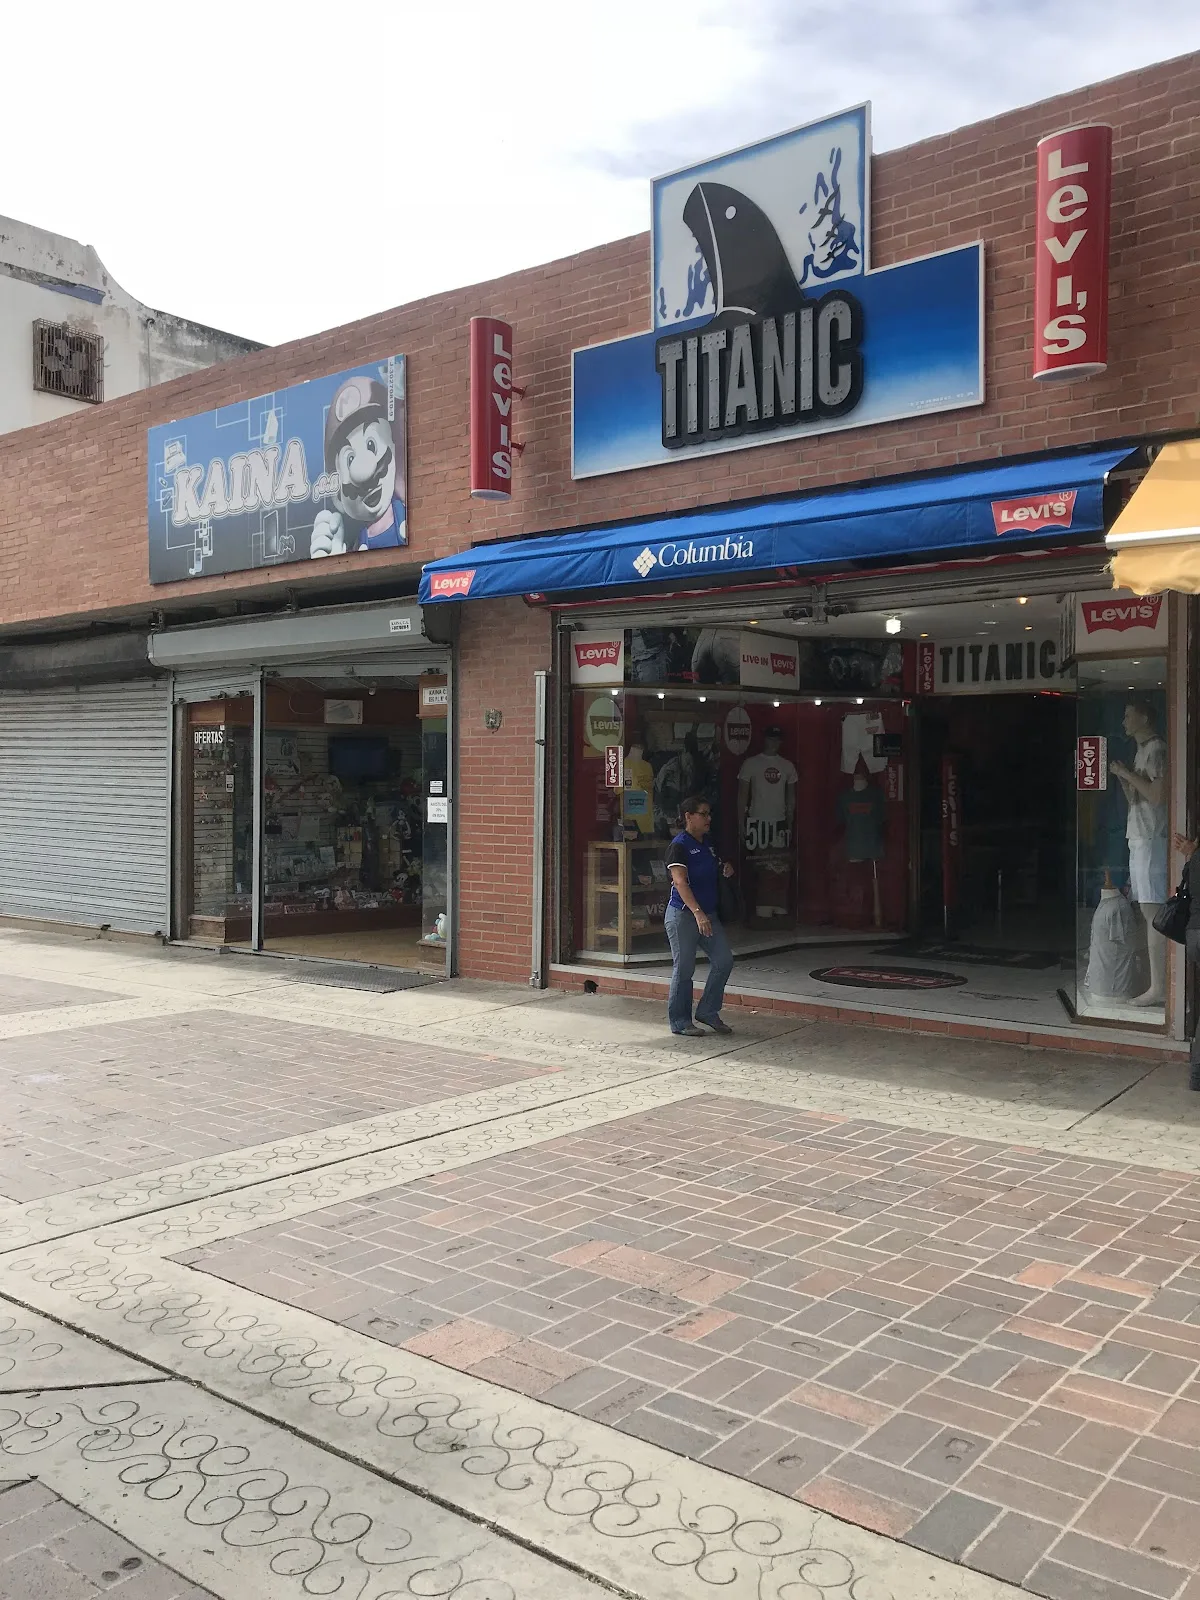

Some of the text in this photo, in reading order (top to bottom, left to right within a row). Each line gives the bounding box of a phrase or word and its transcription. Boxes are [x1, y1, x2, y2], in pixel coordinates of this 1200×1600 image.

[659, 299, 852, 438] TITANIC
[173, 440, 309, 524] KAINA
[658, 536, 754, 569] Columbia
[939, 639, 1056, 684] TITANIC
[194, 731, 223, 744] OFERTAS
